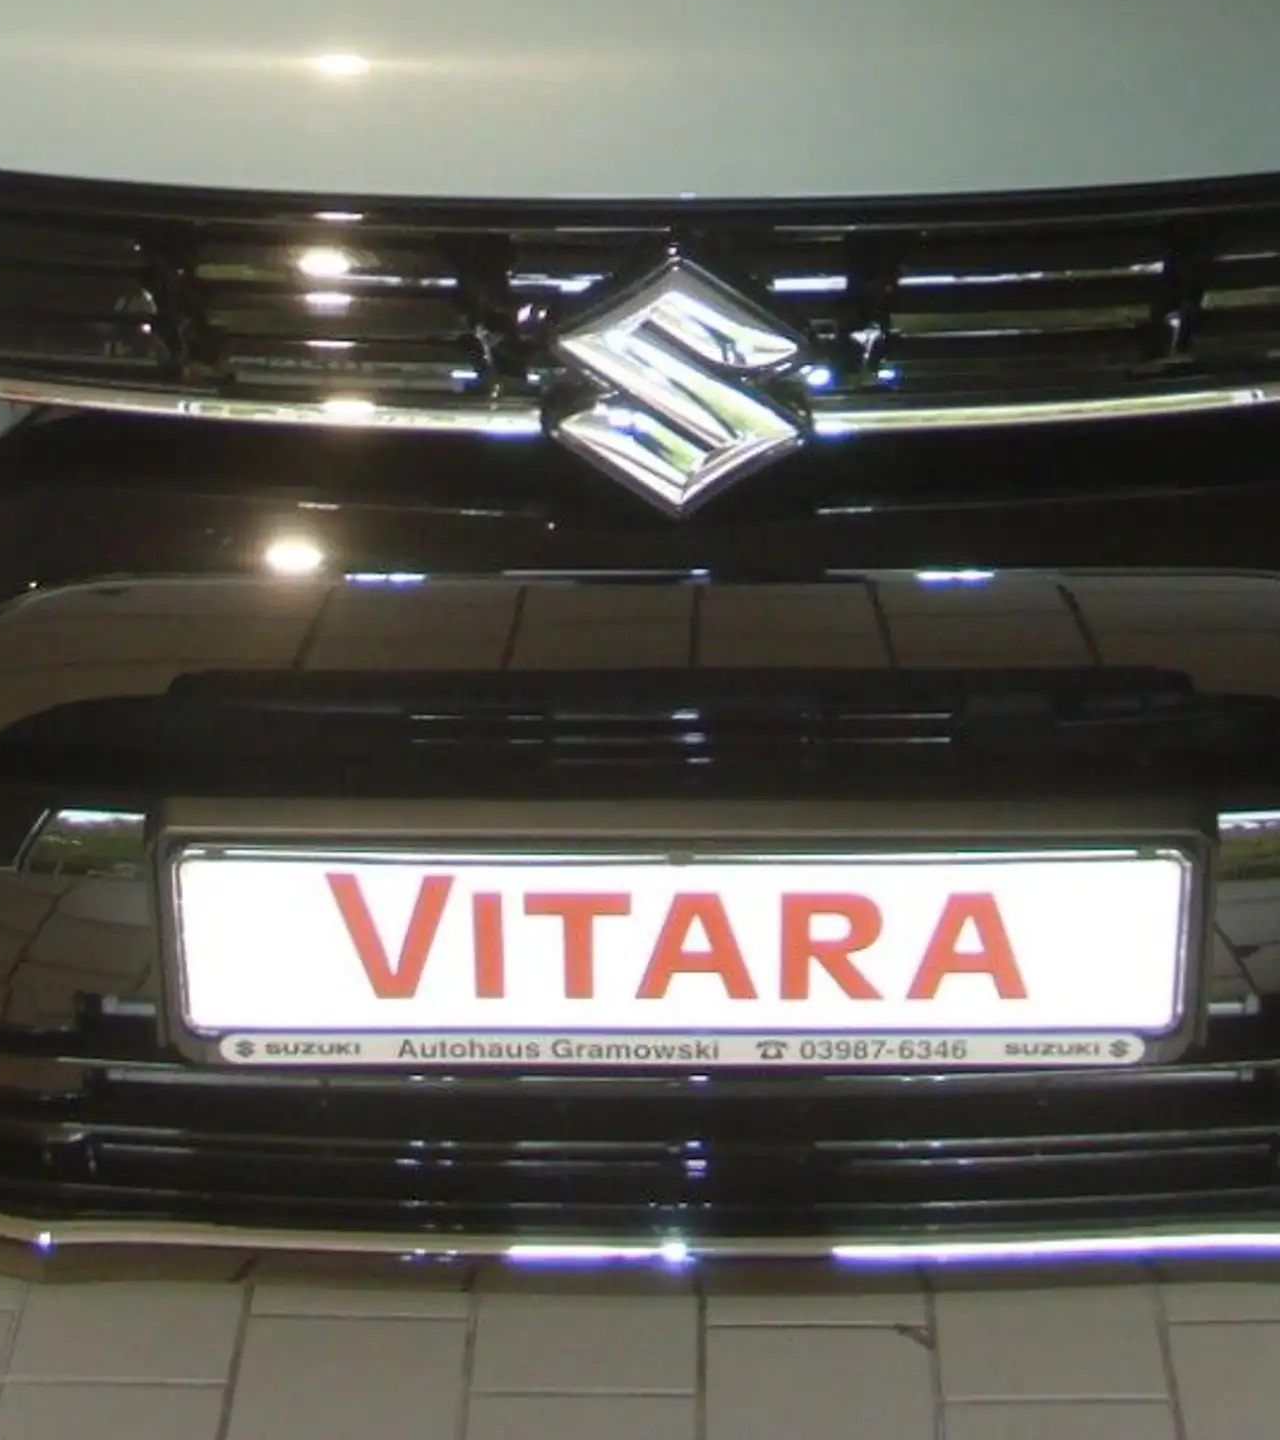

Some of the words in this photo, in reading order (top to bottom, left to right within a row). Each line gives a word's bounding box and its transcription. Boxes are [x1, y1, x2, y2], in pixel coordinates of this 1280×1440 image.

[325, 873, 1029, 999] VITARA
[264, 1041, 363, 1057] SUZUKI
[397, 1038, 541, 1061] Autohaus
[551, 1038, 720, 1062] Gramowski
[799, 1039, 969, 1062] 03987-6346
[1003, 1041, 1101, 1057] SUZUKI
